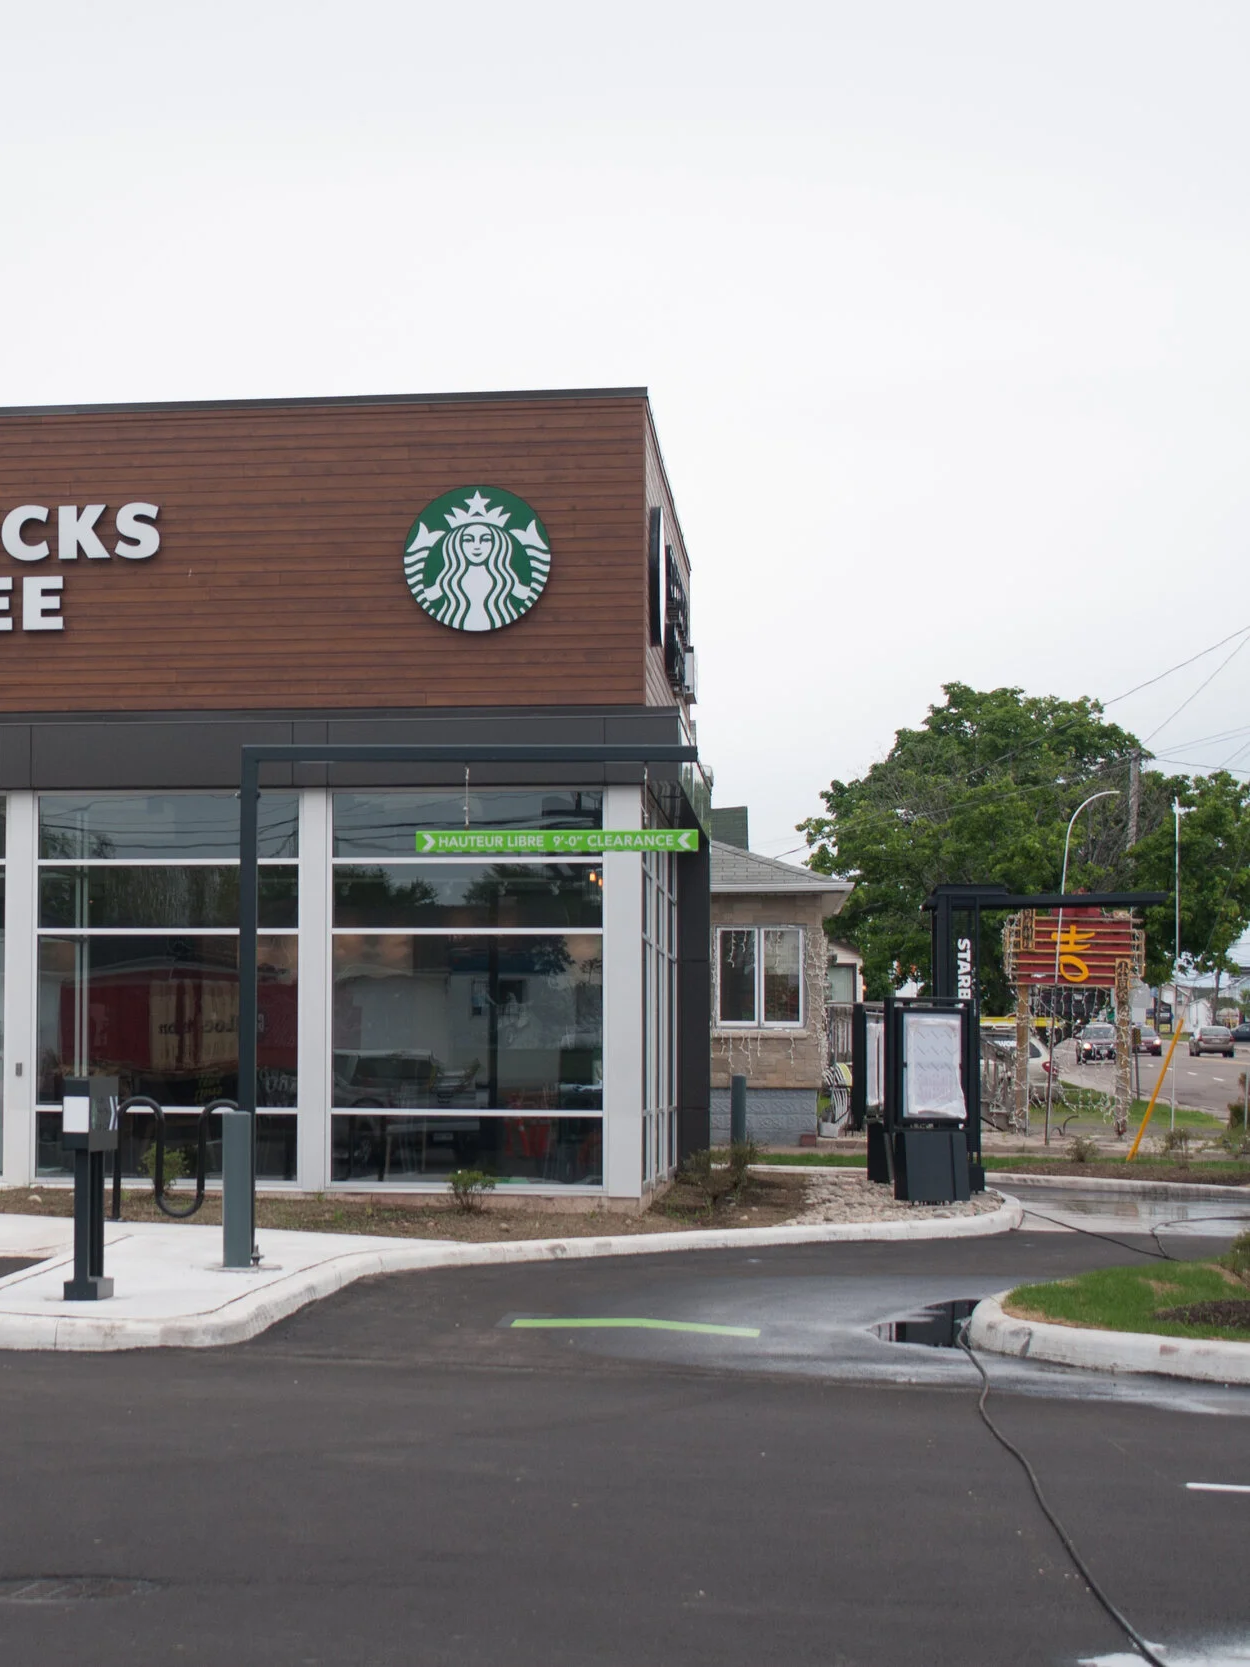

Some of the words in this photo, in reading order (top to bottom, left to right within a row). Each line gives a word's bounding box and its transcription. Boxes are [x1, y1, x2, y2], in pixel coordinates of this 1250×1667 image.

[438, 835, 504, 848] HAUTEUR
[507, 835, 544, 847] LIBRE
[586, 834, 674, 847] CLEARANCE
[957, 938, 972, 1000] STARB
